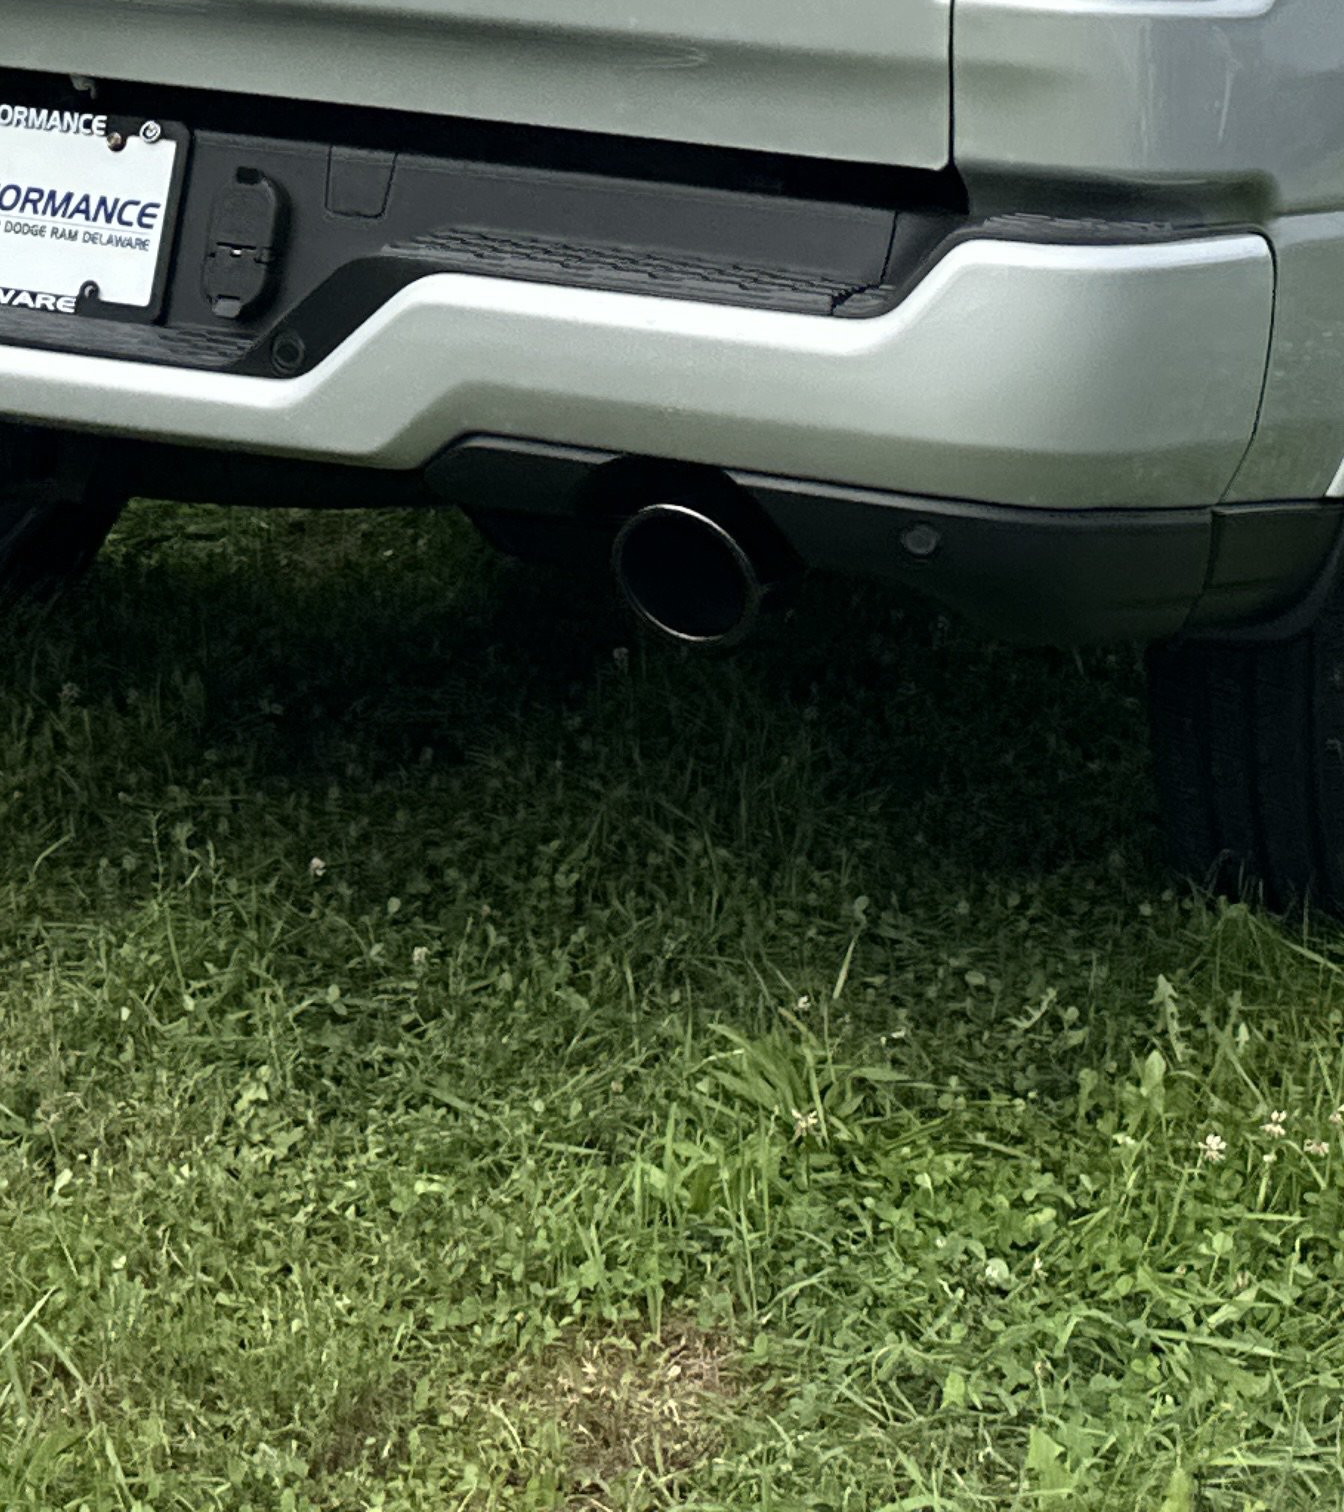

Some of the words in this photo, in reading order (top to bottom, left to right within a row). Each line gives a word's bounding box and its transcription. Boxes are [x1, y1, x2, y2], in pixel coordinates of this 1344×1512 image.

[4, 221, 47, 238] DODGE
[50, 227, 78, 242] RAM
[82, 231, 151, 251] DELAWARE
